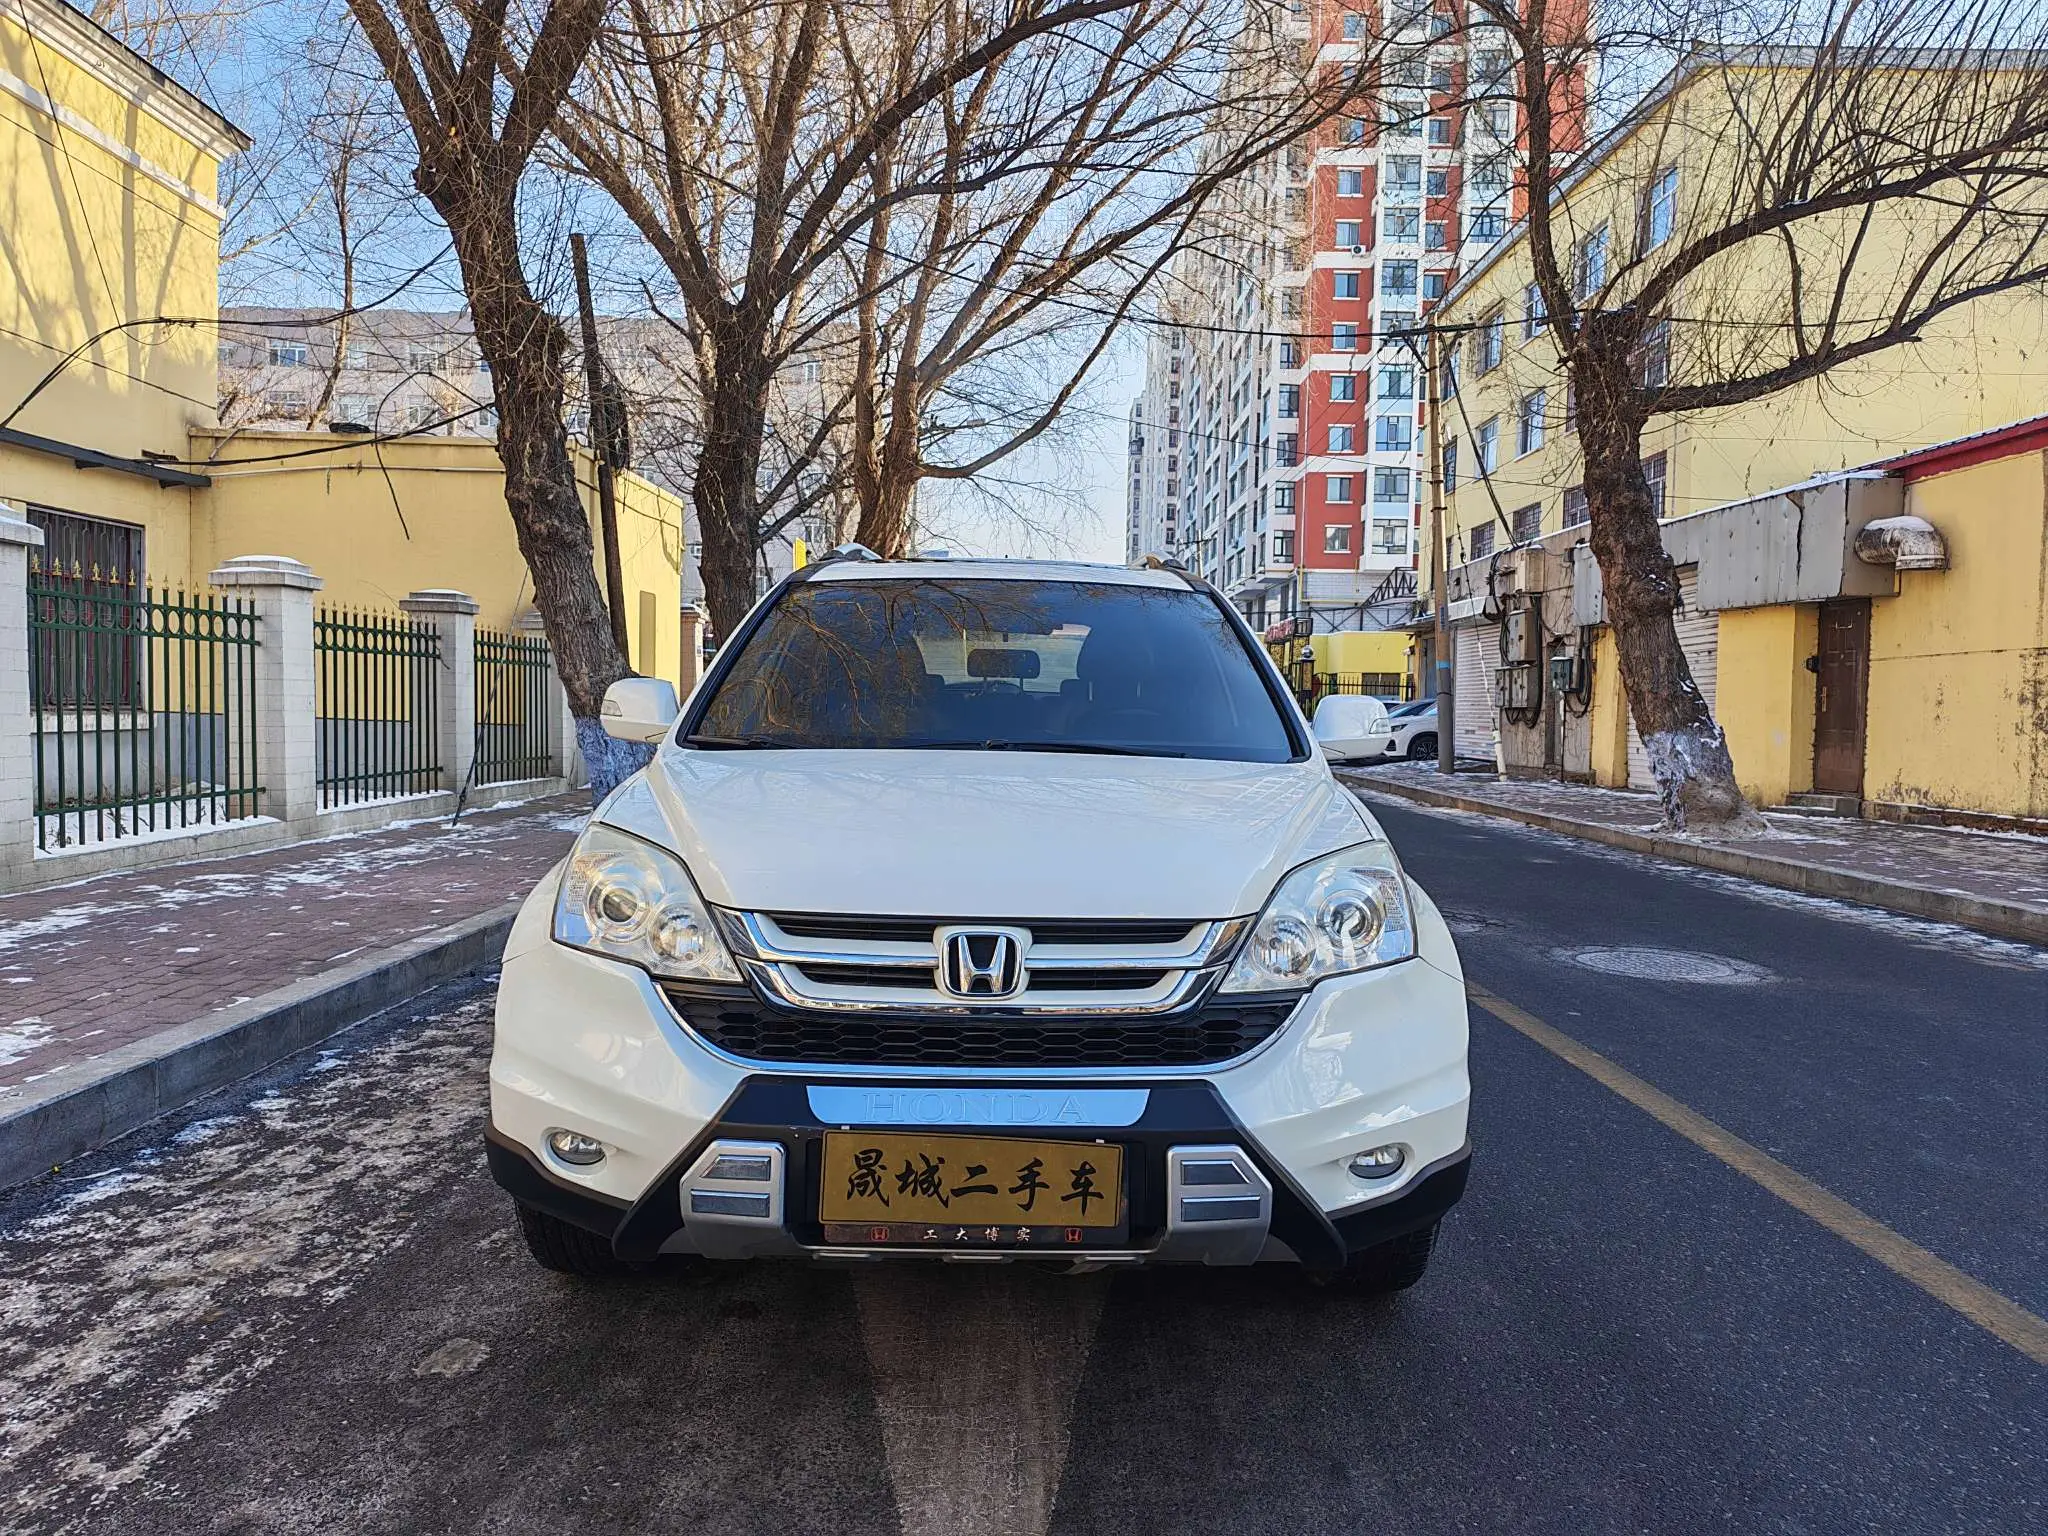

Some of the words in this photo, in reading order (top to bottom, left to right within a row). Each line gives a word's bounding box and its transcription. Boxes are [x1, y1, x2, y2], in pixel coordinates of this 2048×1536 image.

[861, 1091, 1097, 1125] HONDA
[846, 1148, 1106, 1216] 晟城二手车
